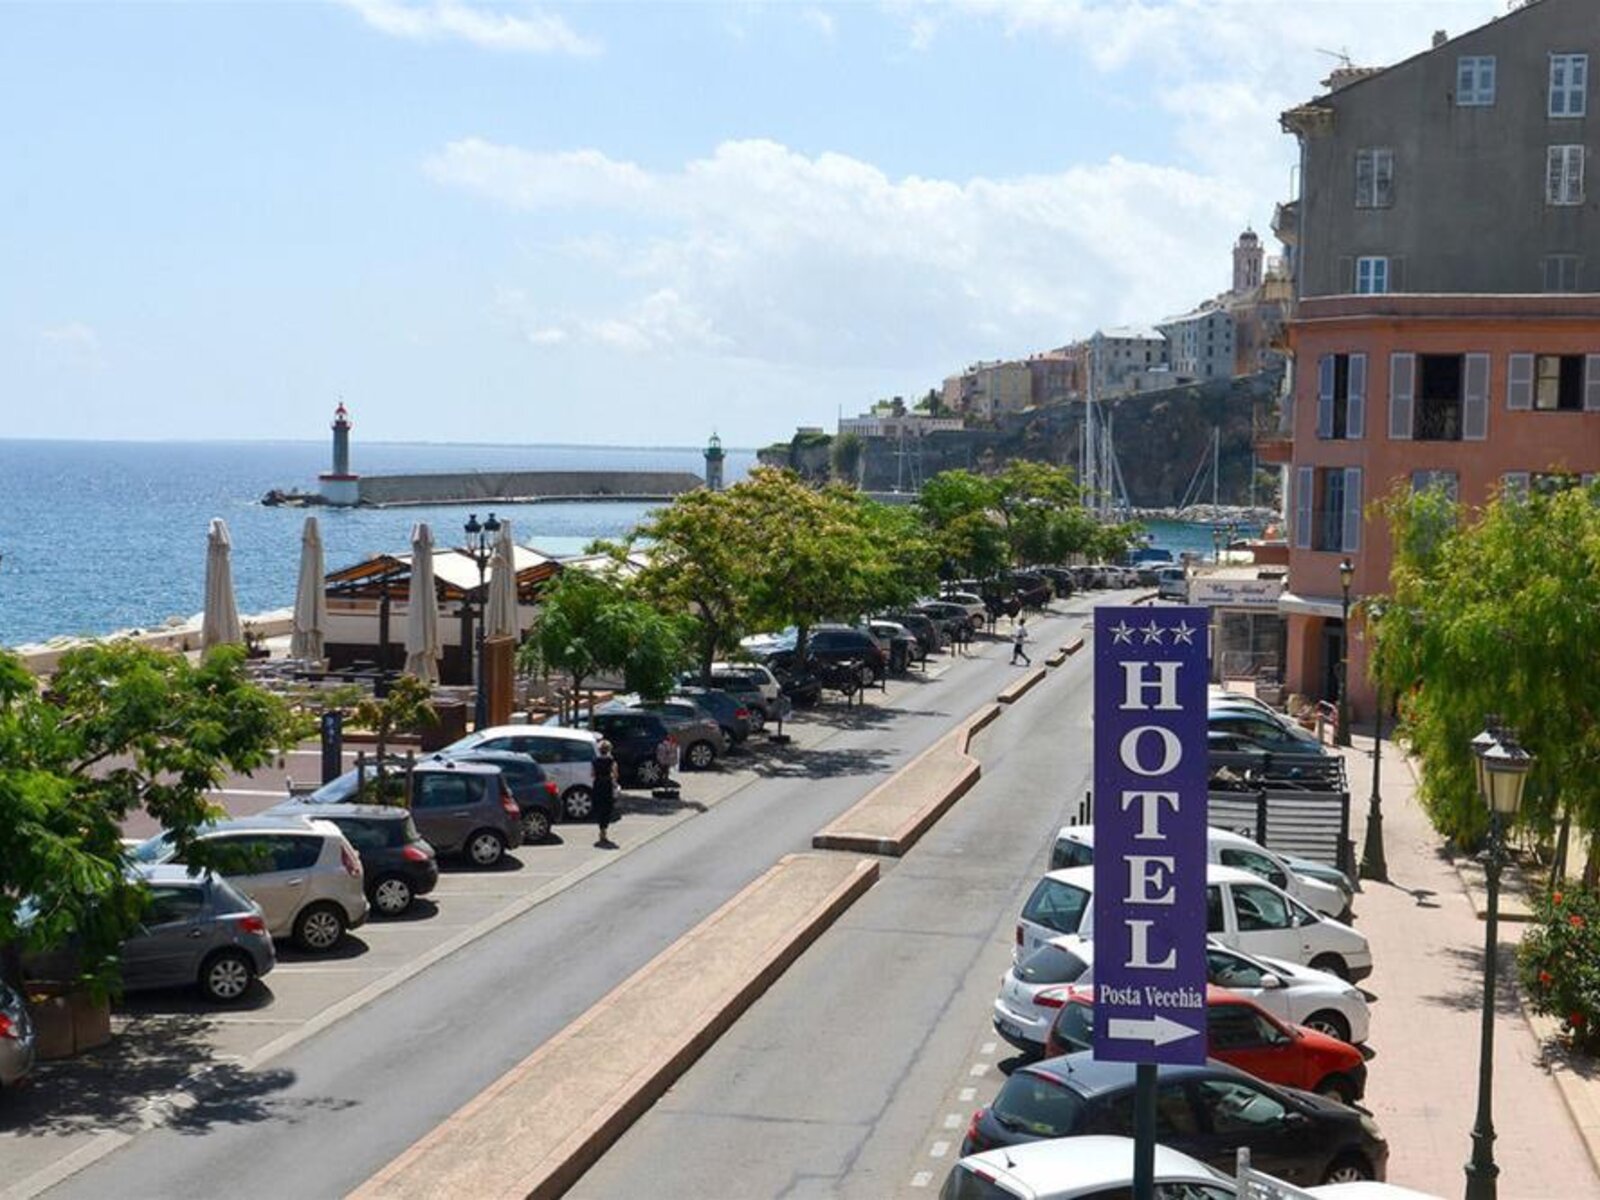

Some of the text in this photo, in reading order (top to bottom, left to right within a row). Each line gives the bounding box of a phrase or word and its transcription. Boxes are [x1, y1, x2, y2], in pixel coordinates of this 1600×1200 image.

[1119, 661, 1183, 970] HOTEL
[1100, 984, 1203, 1008] Posta Vecchia
